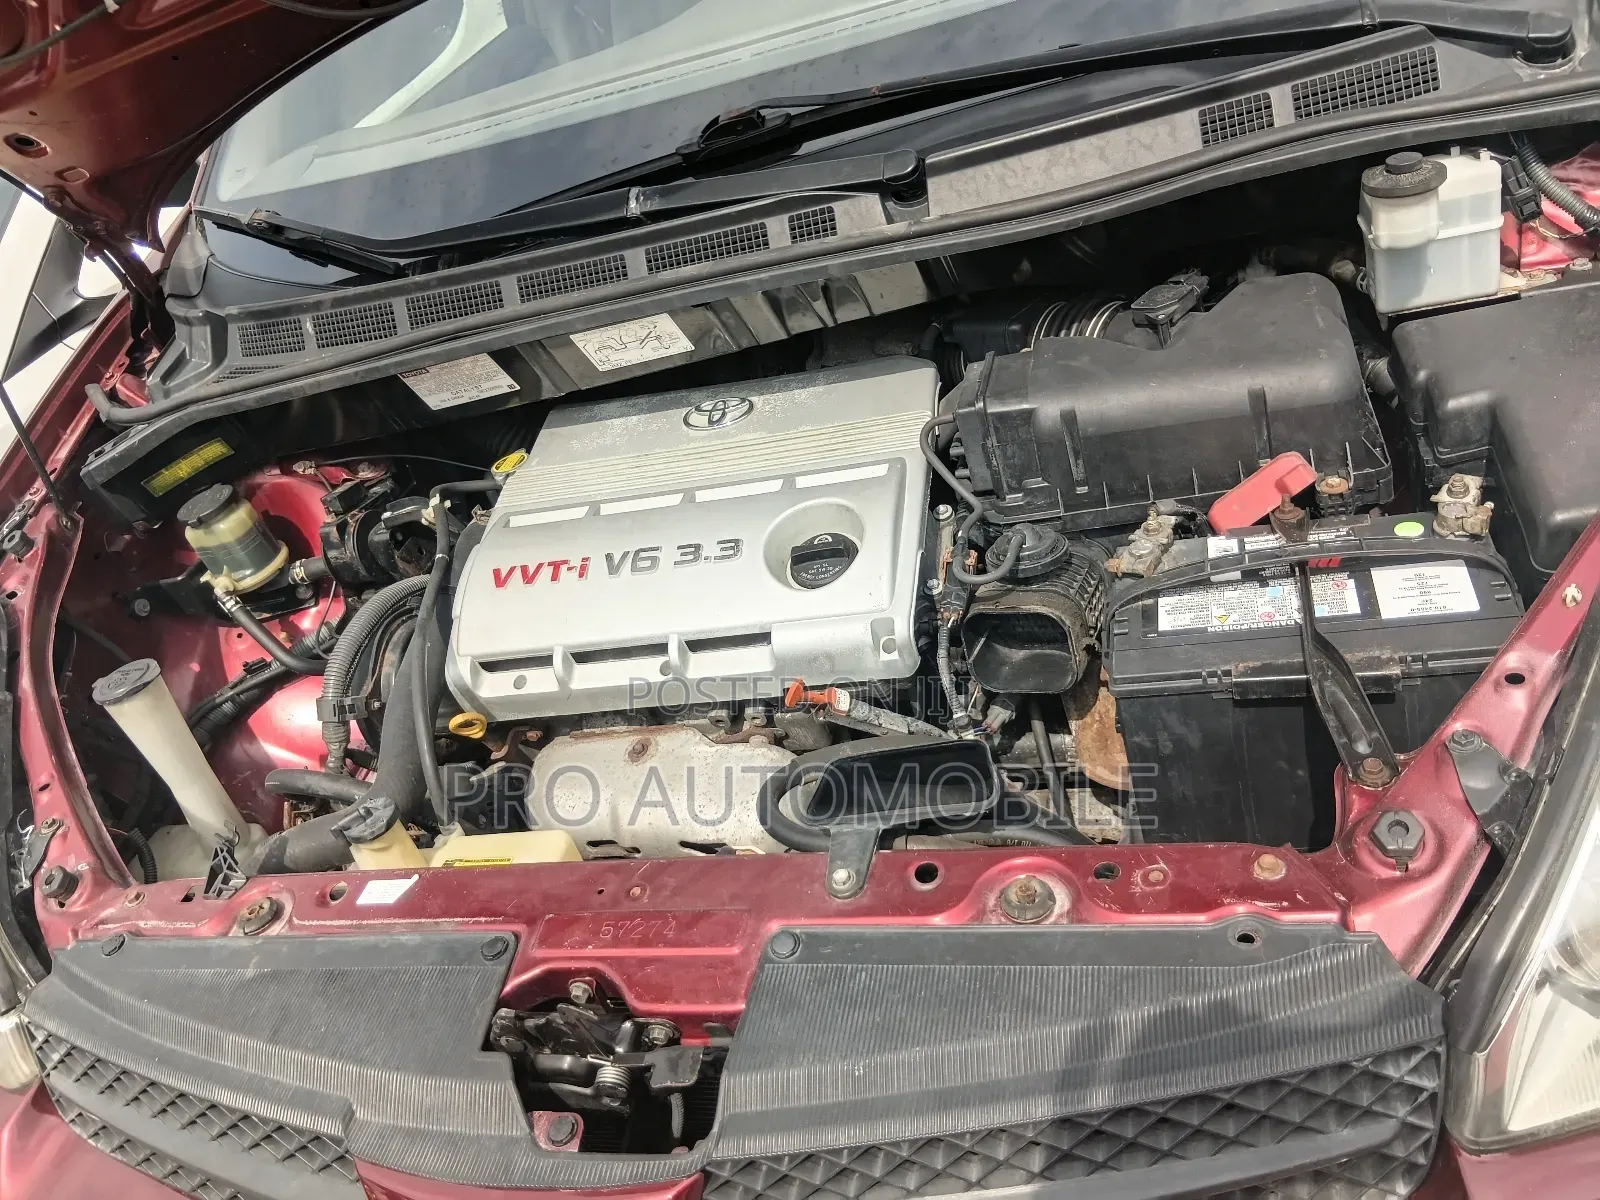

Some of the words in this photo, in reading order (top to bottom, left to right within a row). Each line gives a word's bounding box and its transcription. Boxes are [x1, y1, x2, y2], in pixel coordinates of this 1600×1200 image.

[401, 368, 429, 378] TOYOTA
[492, 556, 591, 590] VVT-i
[604, 546, 662, 579] V6
[673, 538, 744, 569] 3.3
[1207, 618, 1296, 633] DANGER/POISON
[600, 918, 677, 938] 57274
